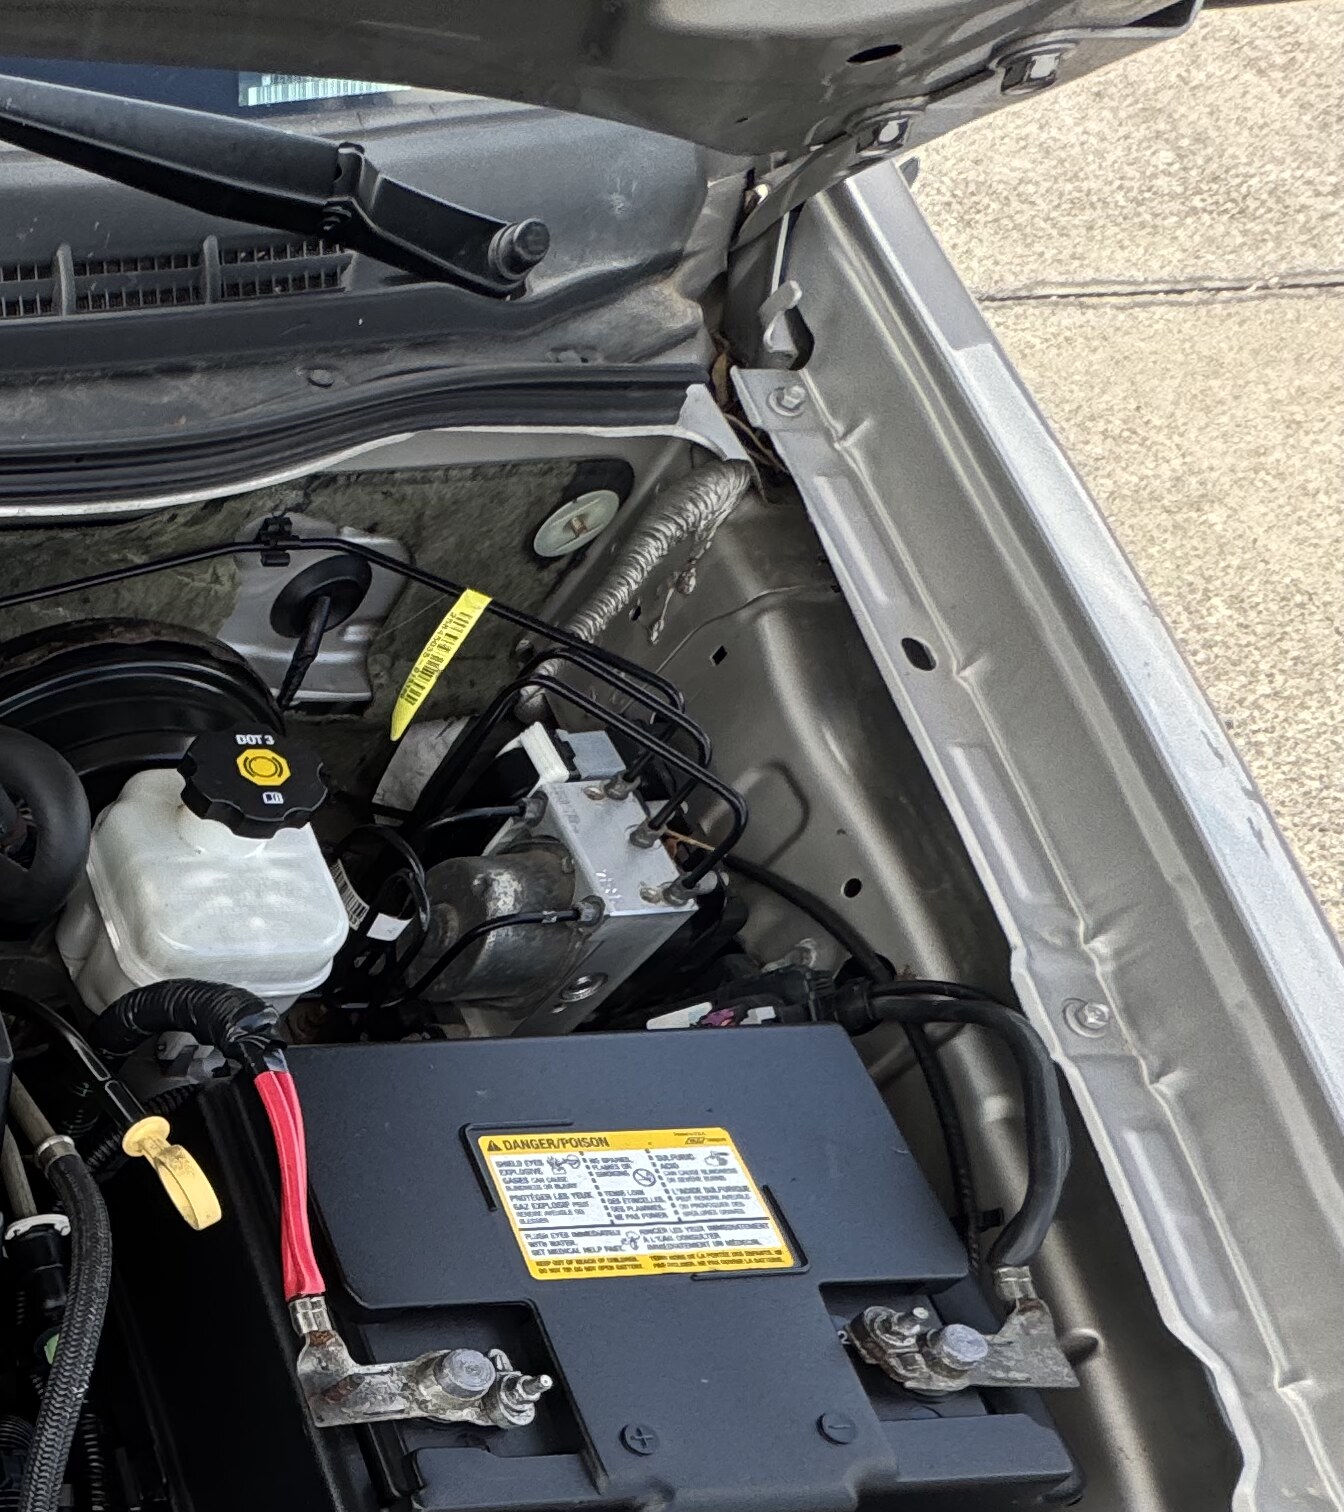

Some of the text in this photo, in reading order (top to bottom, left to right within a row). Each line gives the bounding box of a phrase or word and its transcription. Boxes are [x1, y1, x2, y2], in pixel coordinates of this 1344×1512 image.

[235, 734, 275, 745] DOT 3
[503, 1137, 610, 1150] DANGER/POISON
